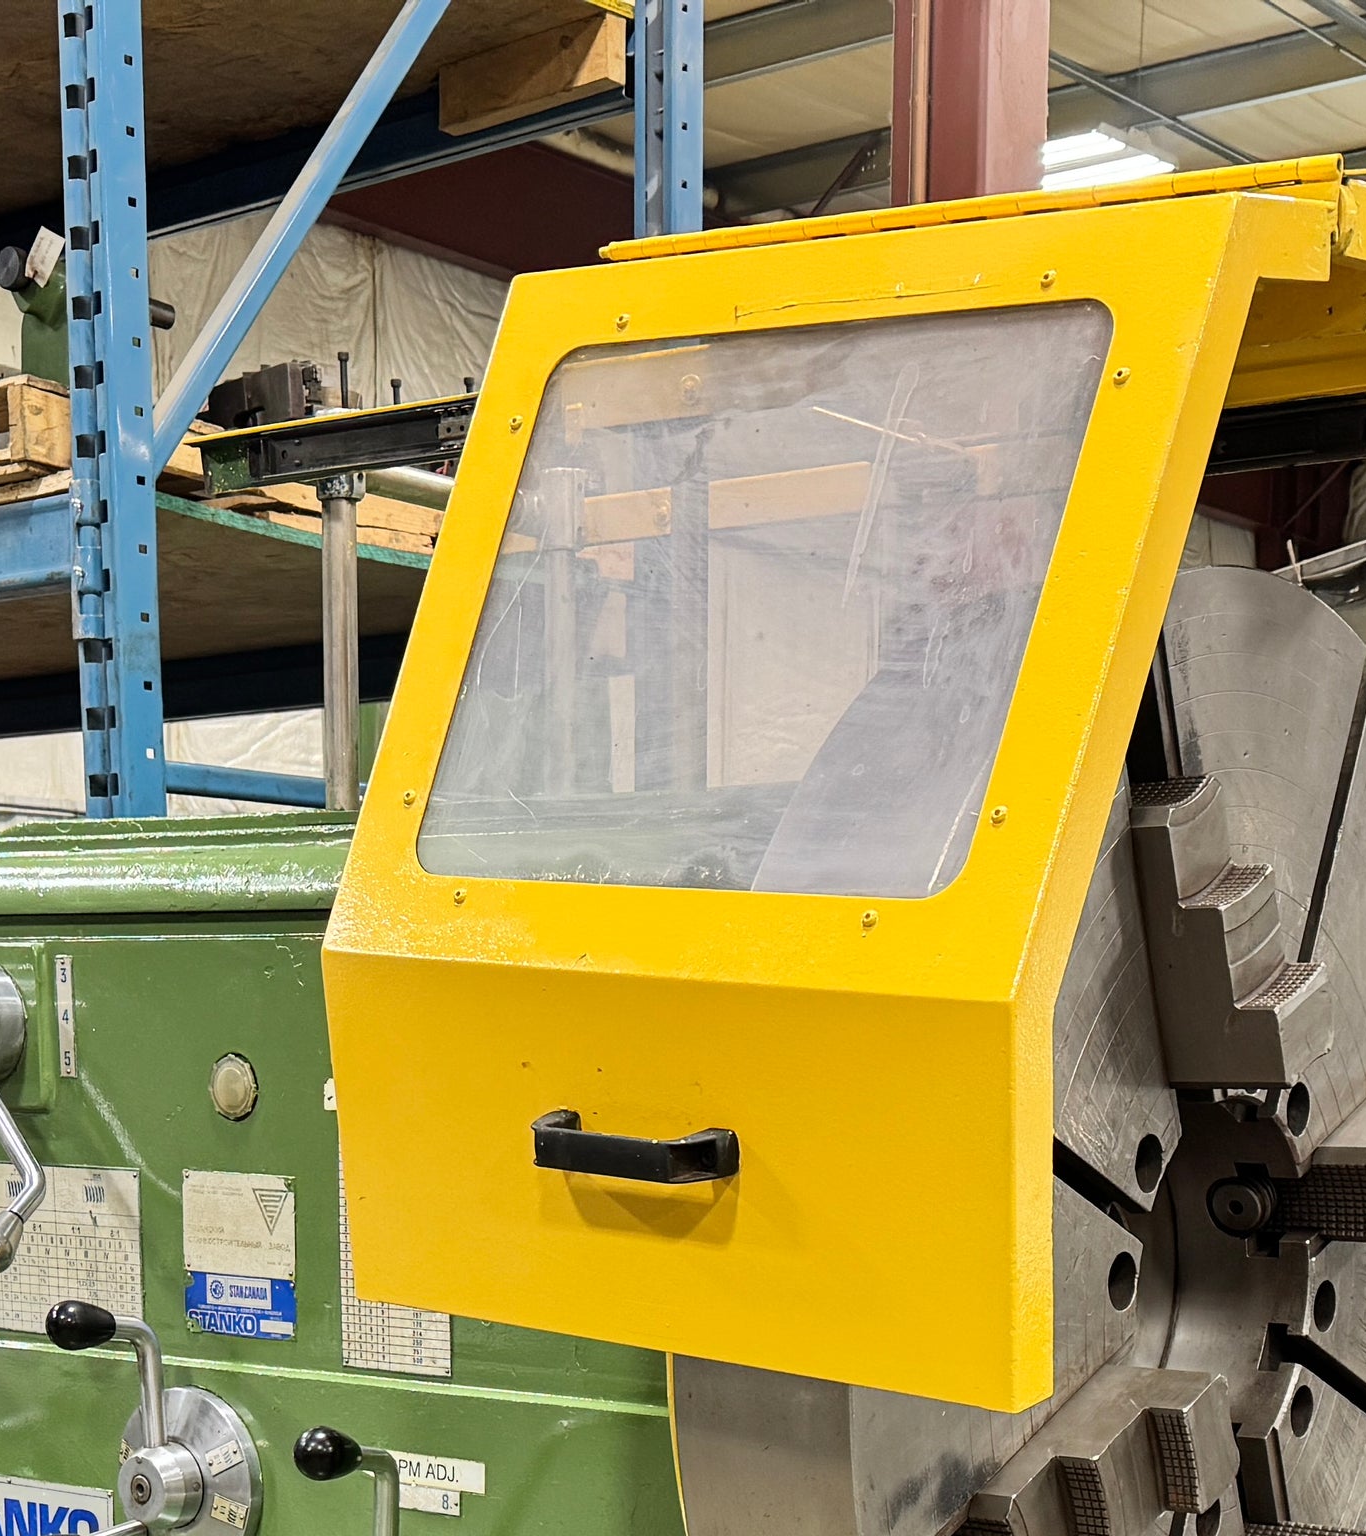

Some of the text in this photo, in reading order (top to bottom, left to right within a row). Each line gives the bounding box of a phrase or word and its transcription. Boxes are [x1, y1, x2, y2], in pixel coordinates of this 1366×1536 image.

[60, 968, 67, 983] 3
[62, 1013, 69, 1025] 4
[64, 1051, 71, 1066] 5
[187, 1309, 257, 1336] STANKO
[398, 1458, 459, 1483] PM ADJ.
